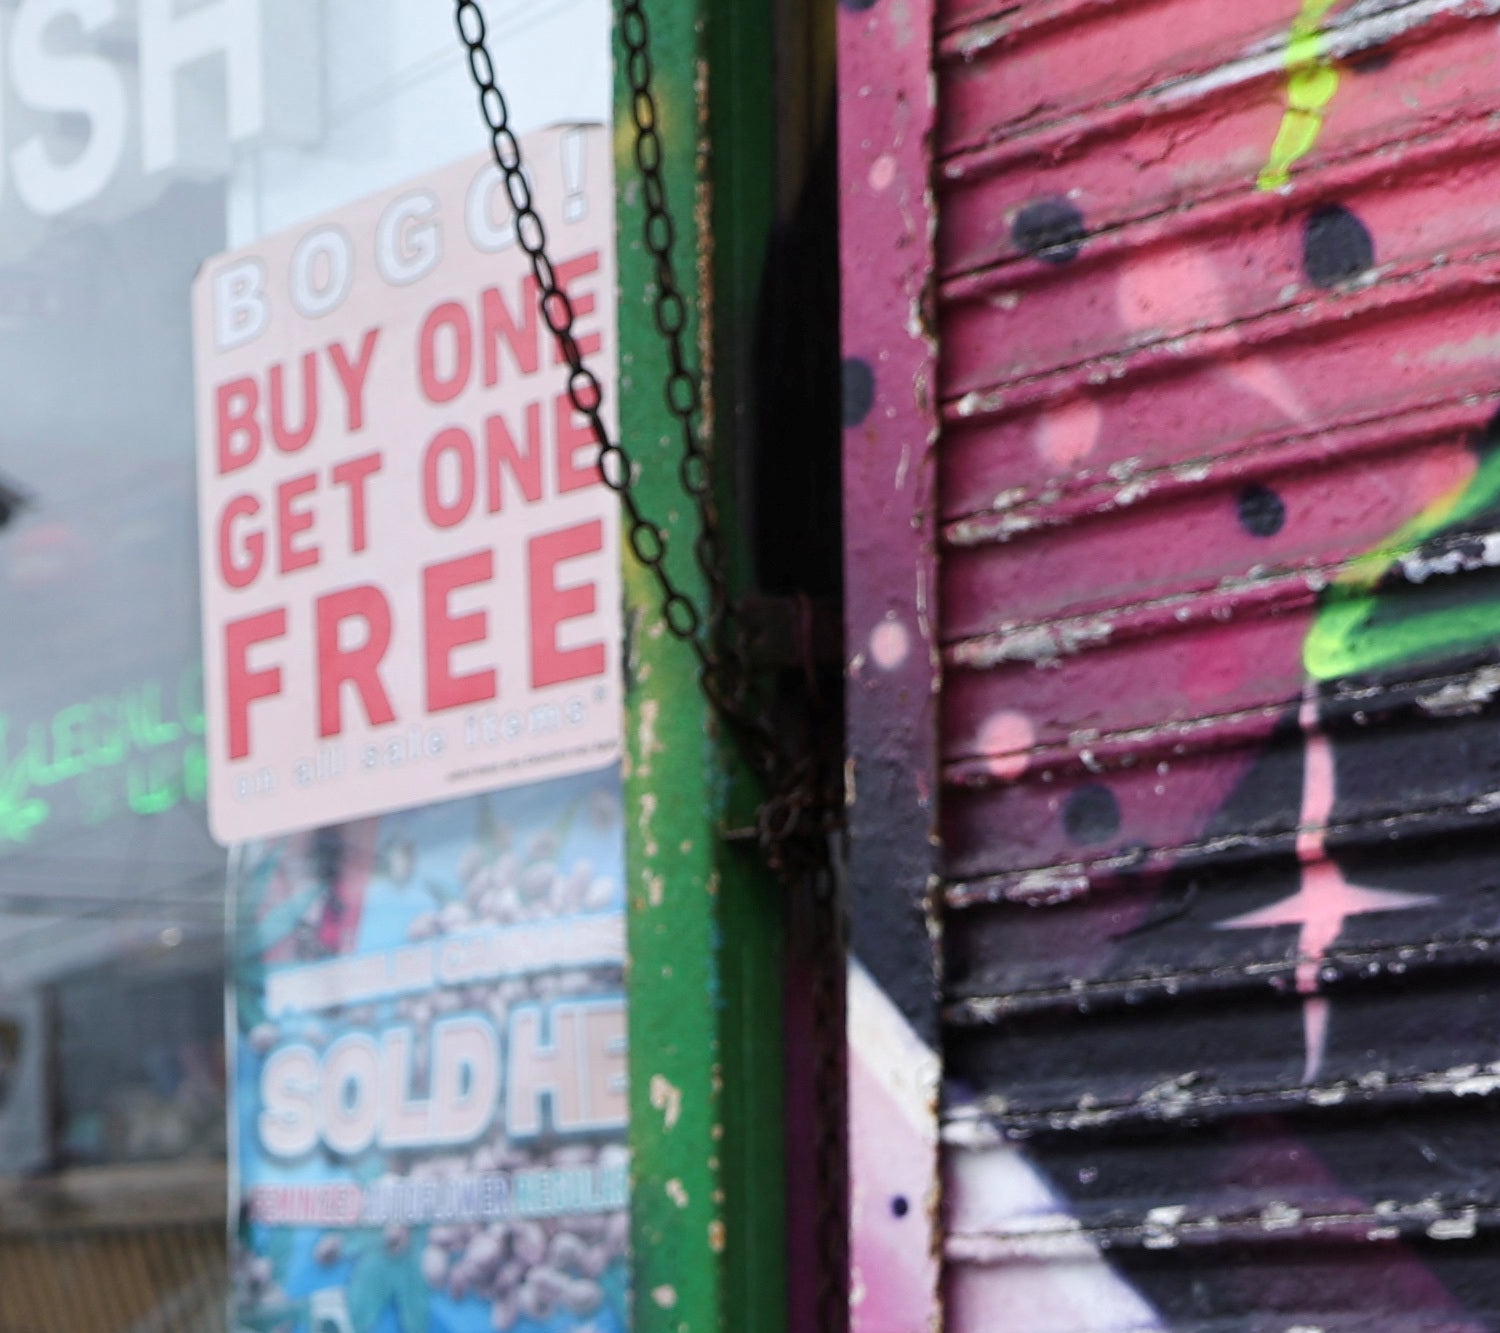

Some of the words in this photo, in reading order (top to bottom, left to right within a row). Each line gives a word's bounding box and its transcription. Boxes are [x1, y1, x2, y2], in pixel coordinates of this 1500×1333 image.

[212, 127, 588, 353] BOGO!
[216, 328, 381, 475] BUY
[418, 250, 604, 403] ONE
[217, 453, 382, 591] GET
[422, 384, 605, 529] ONE
[224, 518, 605, 761] FREE
[362, 723, 447, 773] sale
[260, 1015, 501, 1157] SOLD
